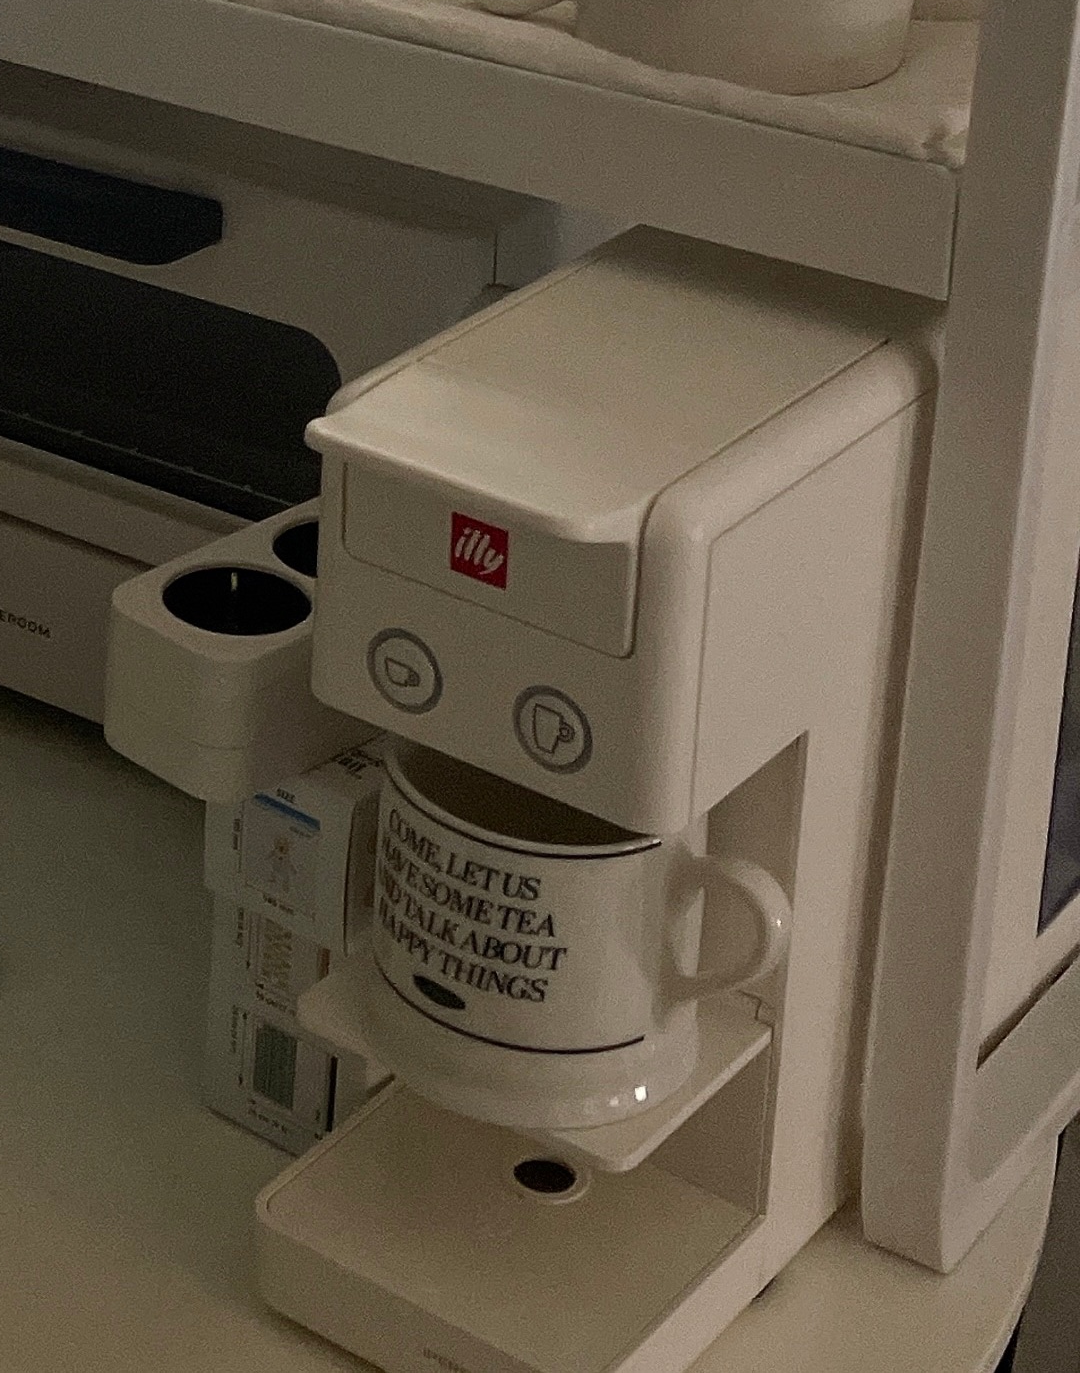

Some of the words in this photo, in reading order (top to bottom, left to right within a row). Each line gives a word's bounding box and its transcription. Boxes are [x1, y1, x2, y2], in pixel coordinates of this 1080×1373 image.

[454, 526, 505, 575] illy
[446, 852, 501, 891] LET
[502, 873, 542, 901] US
[404, 891, 459, 946] TALK
[460, 929, 568, 971] ABOUT
[421, 874, 495, 925] SOME
[497, 904, 556, 938] TEA
[437, 949, 549, 1002] THINGS
